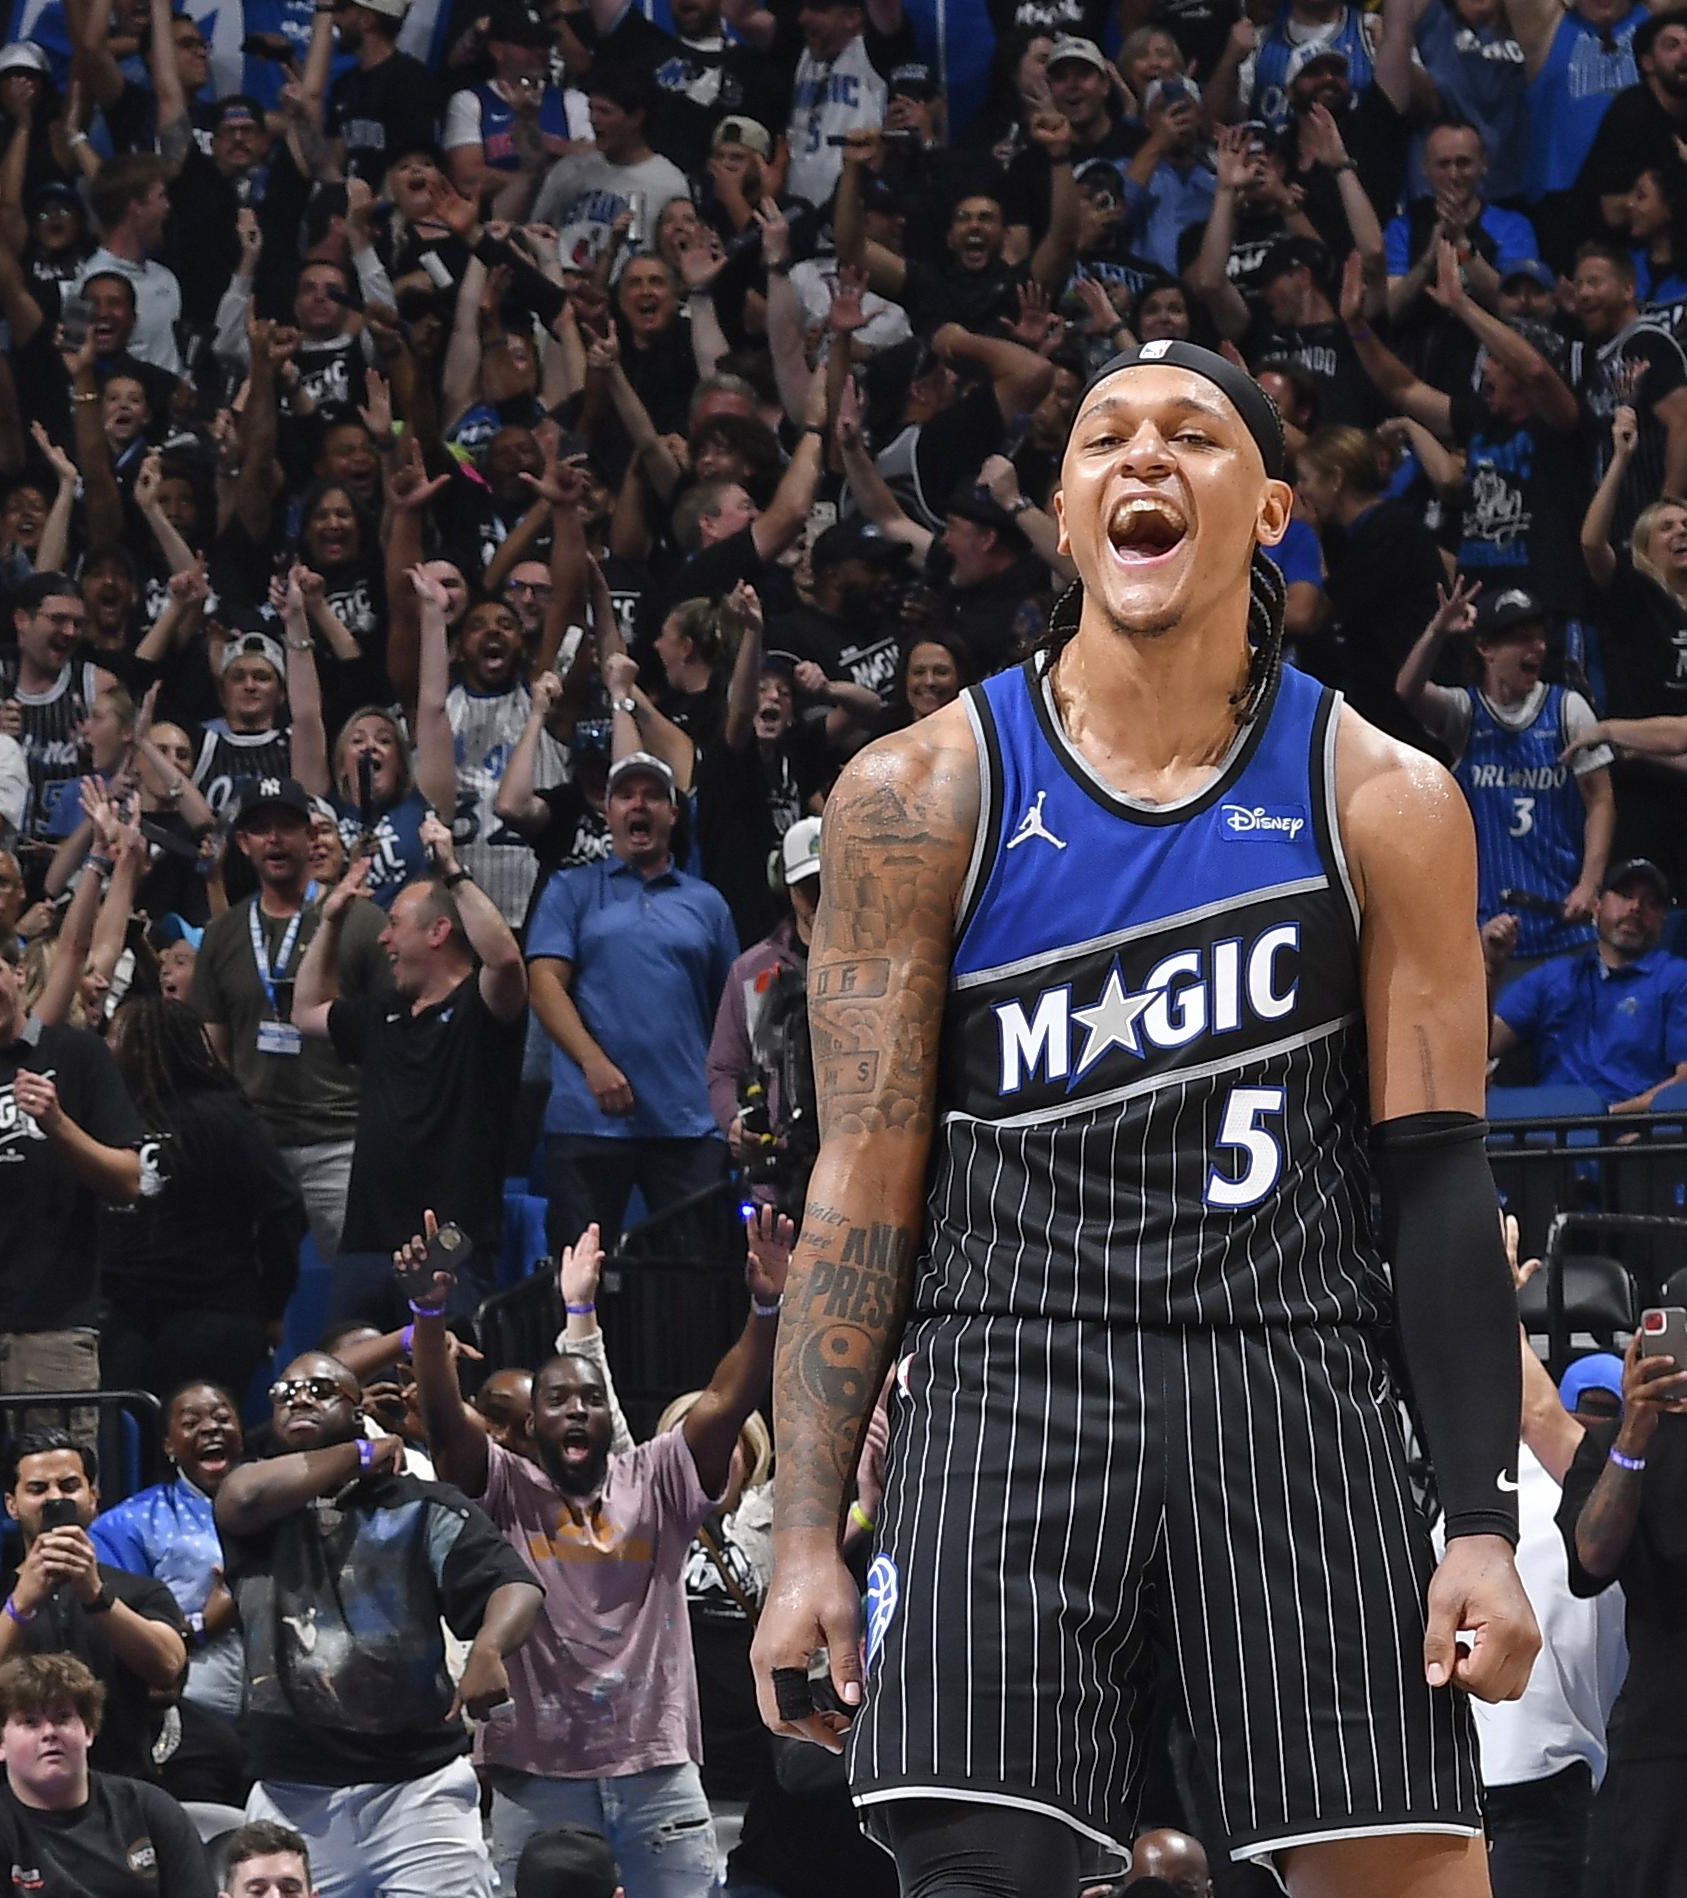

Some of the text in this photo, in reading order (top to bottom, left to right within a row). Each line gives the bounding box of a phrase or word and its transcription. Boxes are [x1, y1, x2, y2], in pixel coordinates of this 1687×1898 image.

[1220, 803, 1304, 839] Disney
[1508, 797, 1536, 839] 3
[991, 920, 1301, 1096] MAGIC
[1200, 1085, 1286, 1210] 5
